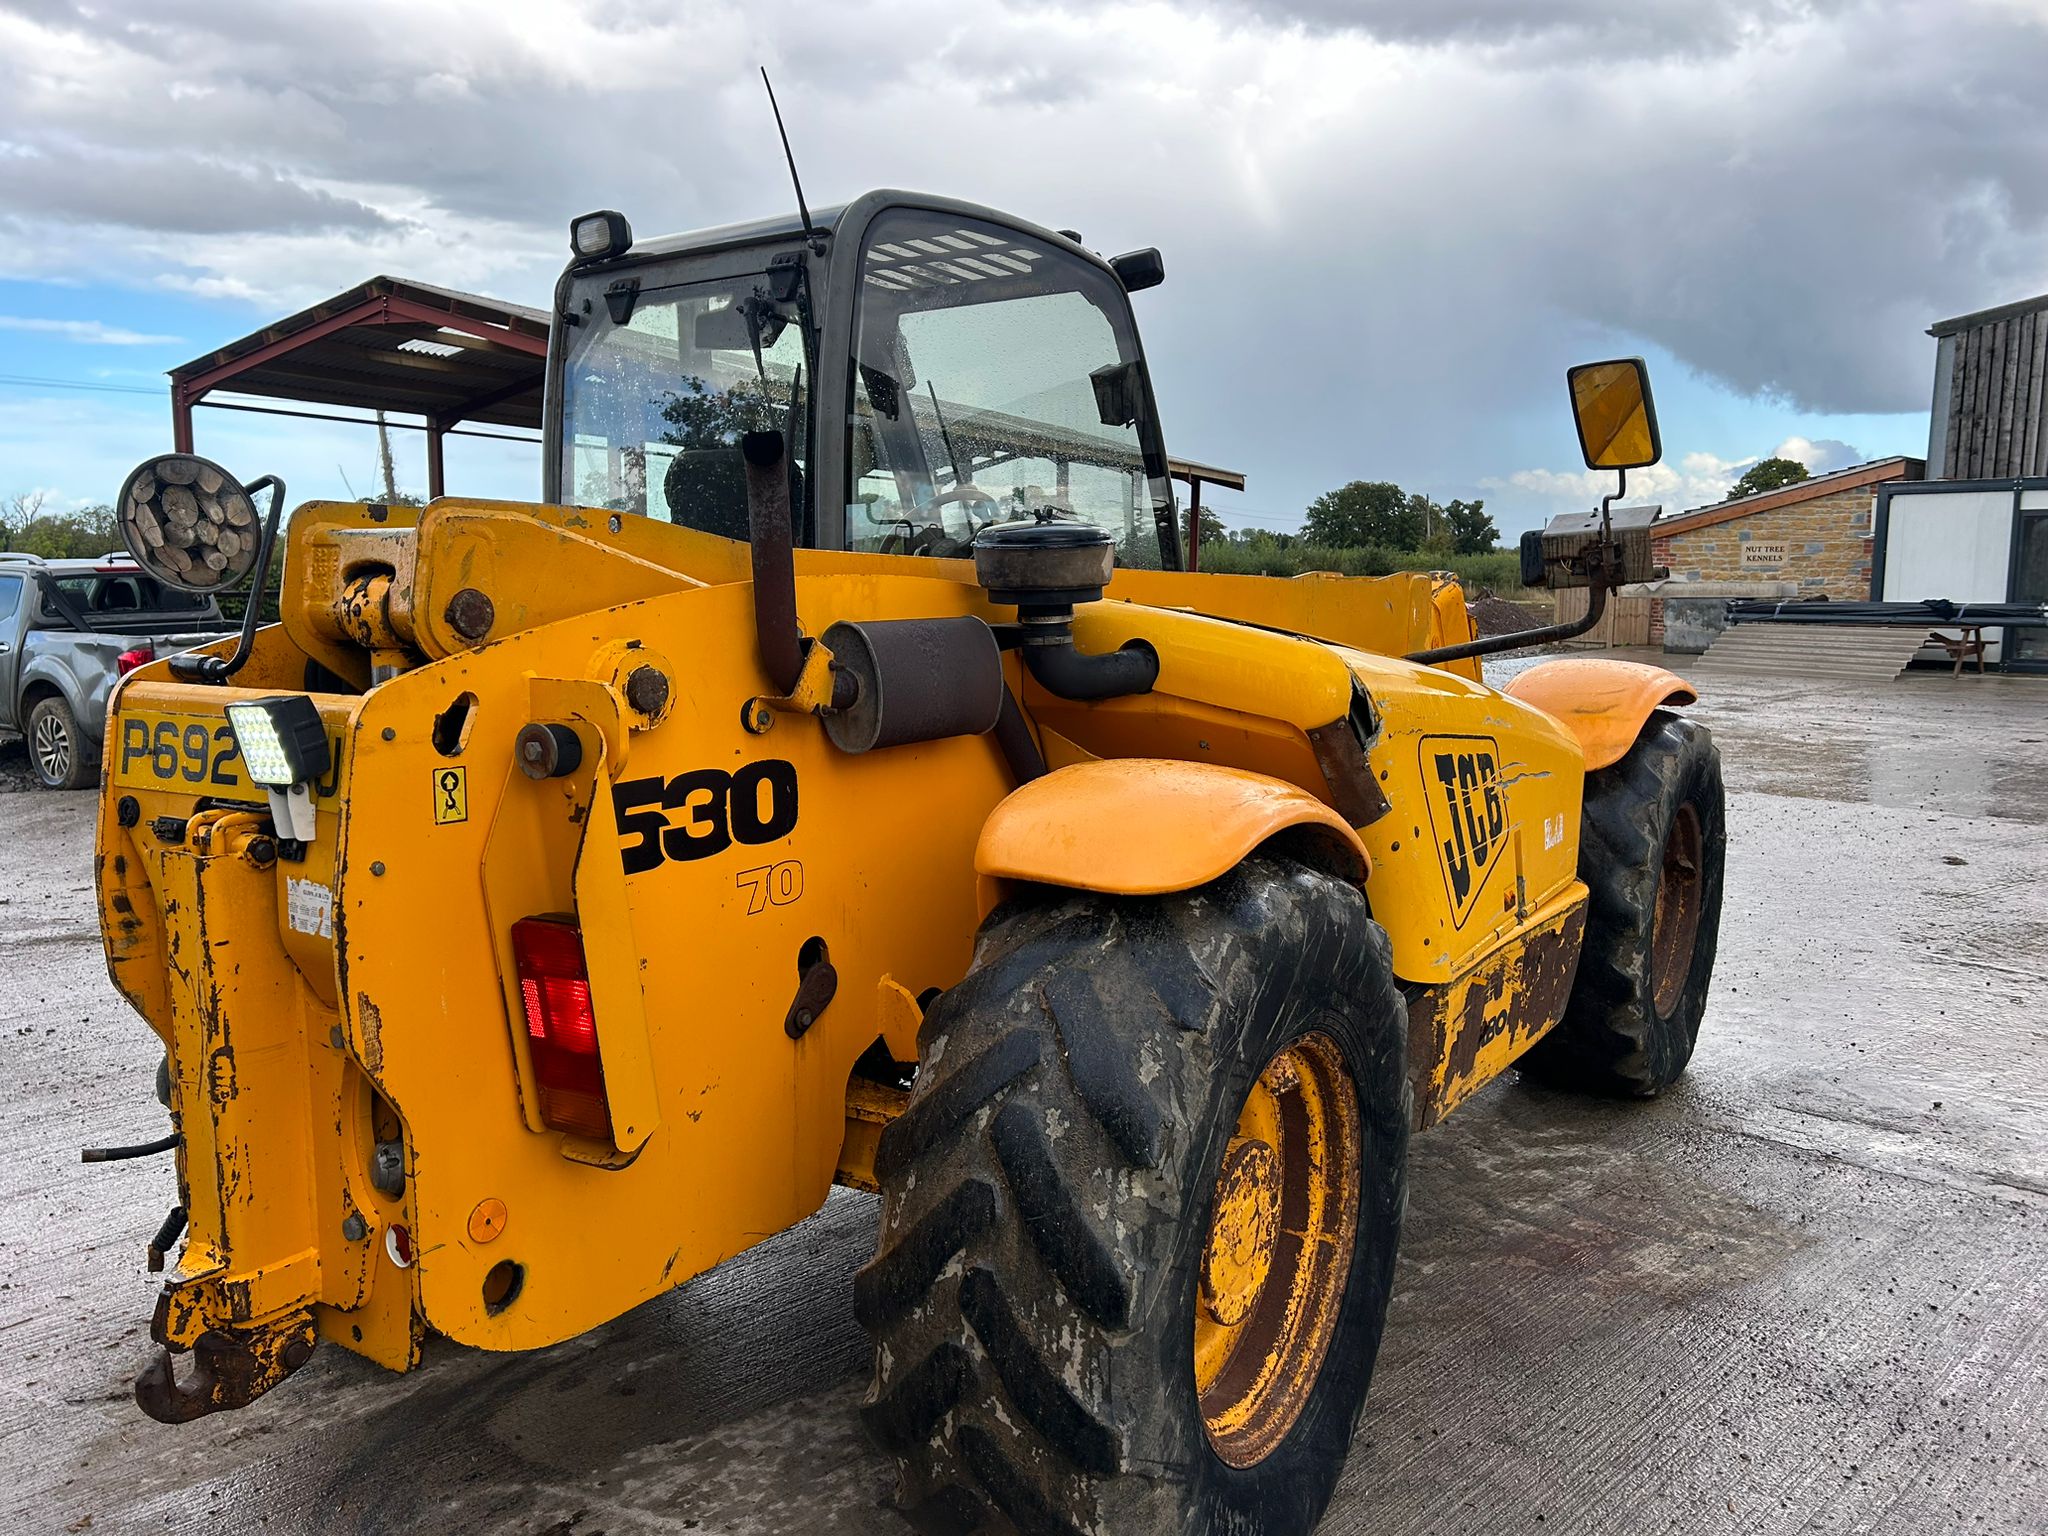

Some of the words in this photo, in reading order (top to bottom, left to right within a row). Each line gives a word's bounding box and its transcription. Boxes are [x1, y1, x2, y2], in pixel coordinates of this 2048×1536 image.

[611, 759, 799, 876] 530
[1434, 753, 1503, 909] JCB
[736, 860, 804, 916] 70
